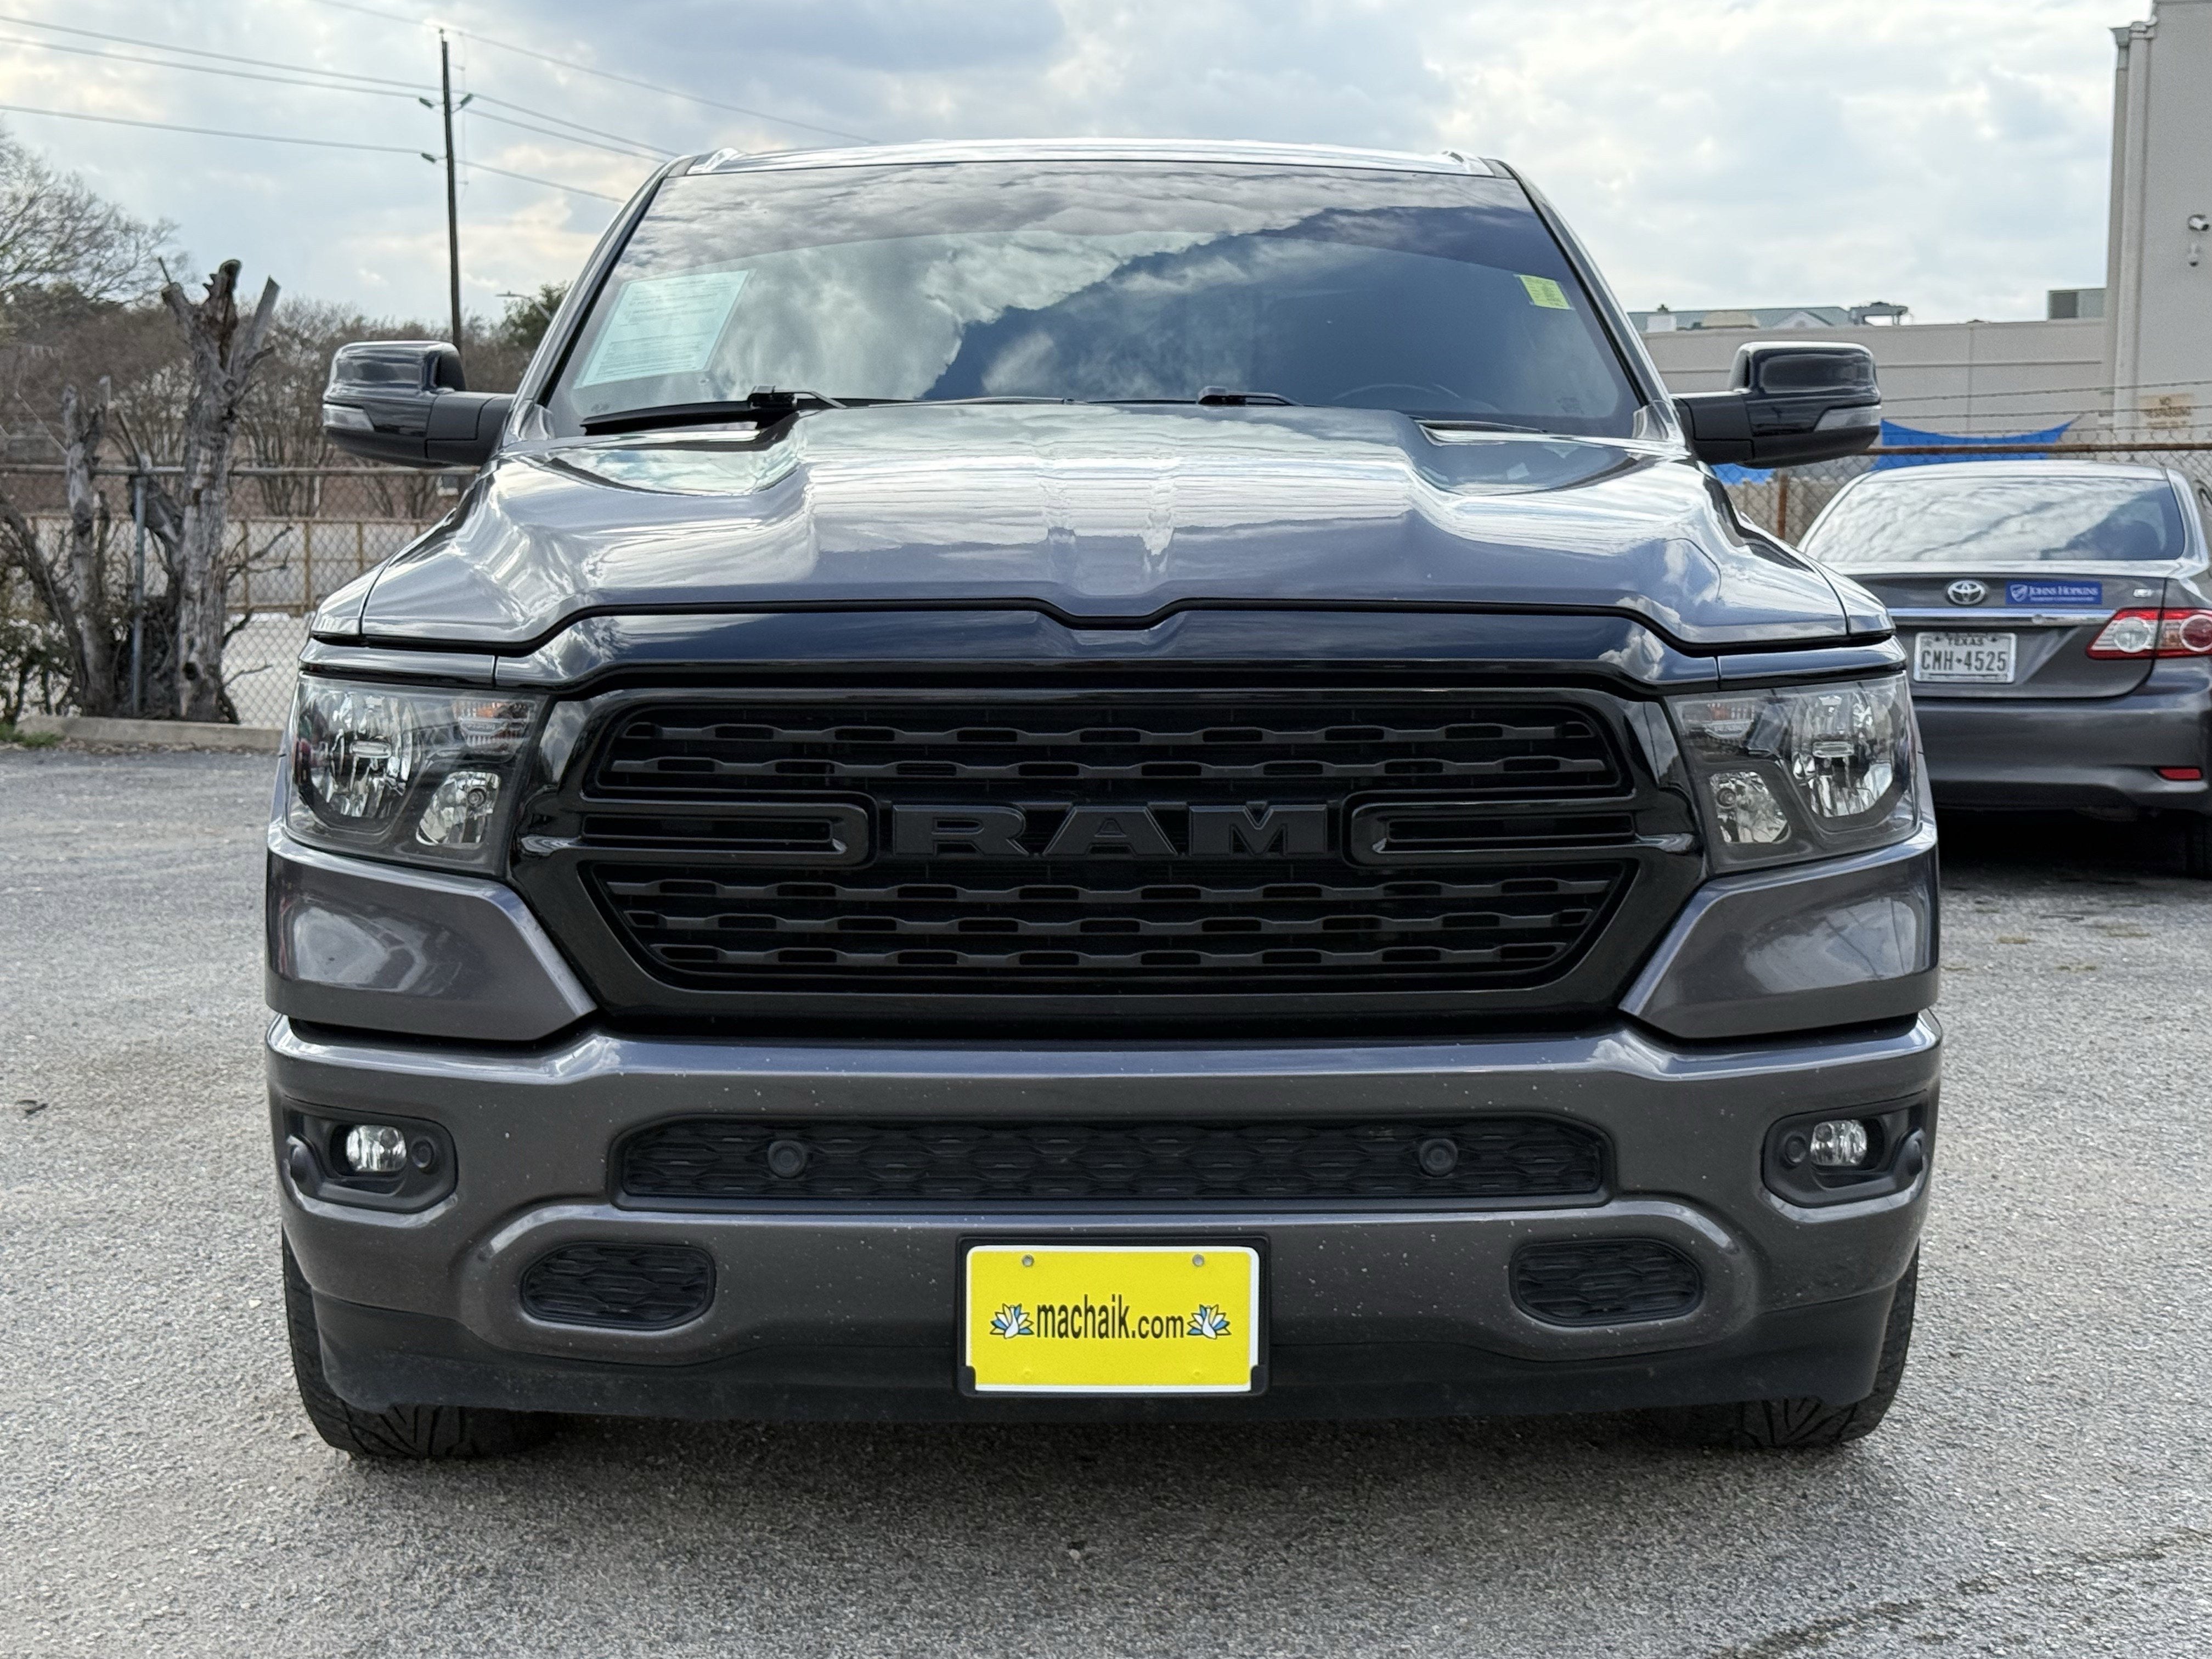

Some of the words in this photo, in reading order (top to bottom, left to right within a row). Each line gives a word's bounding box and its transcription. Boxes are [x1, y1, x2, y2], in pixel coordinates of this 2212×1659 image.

[1948, 637, 1984, 646] TEXAS
[891, 804, 1328, 856] RAM
[1036, 1294, 1184, 1339] machaik.com
